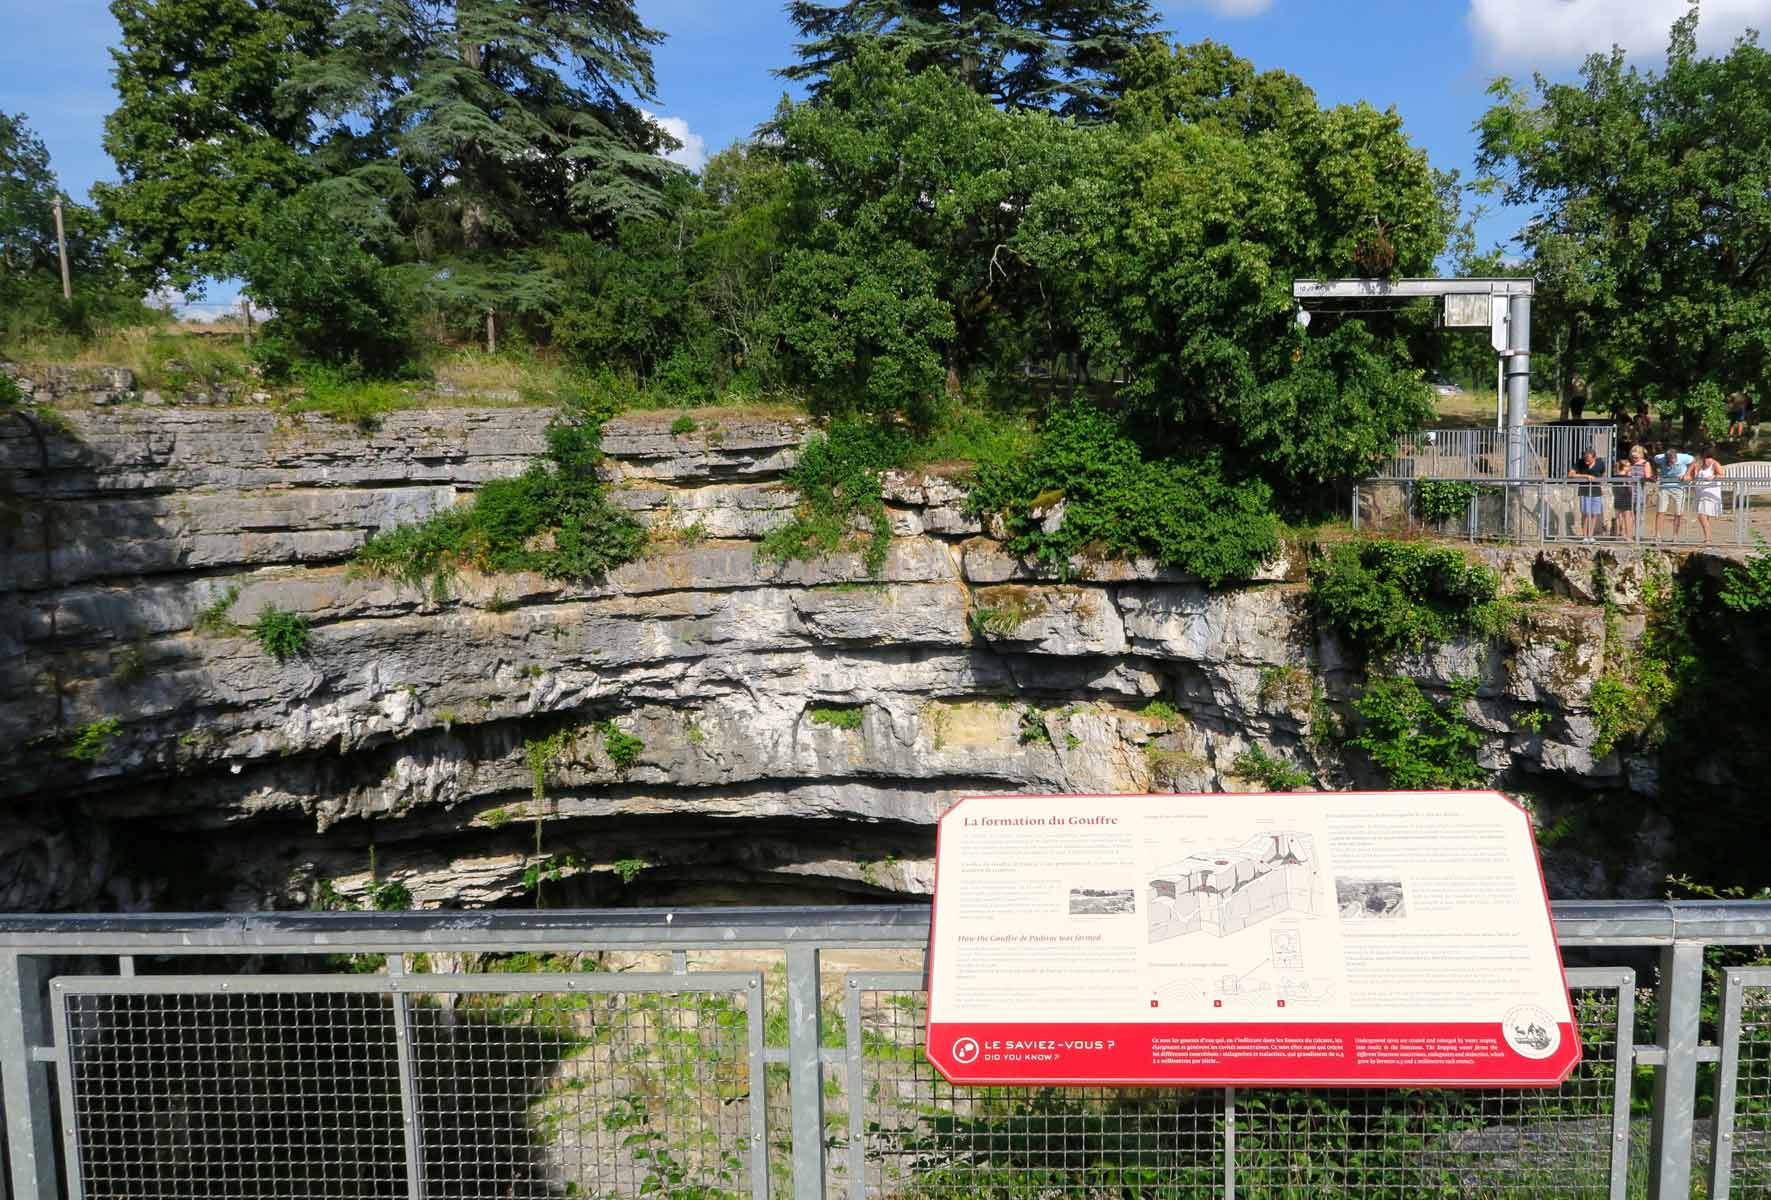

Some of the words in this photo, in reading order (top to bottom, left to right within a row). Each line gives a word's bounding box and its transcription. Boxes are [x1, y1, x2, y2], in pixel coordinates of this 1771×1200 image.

[964, 816, 978, 827] La
[981, 816, 1045, 827] formation
[1048, 815, 1066, 826] du
[1068, 815, 1119, 826] Gouffre
[958, 935, 974, 943] How
[976, 935, 988, 943] the
[1019, 935, 1027, 943] de
[985, 1040, 1001, 1050] LE
[1005, 1040, 1104, 1050] SAVIEZ-VOUS
[1107, 1040, 1115, 1050] ?
[984, 1053, 1001, 1061] DID
[1003, 1053, 1022, 1061] YOU
[1024, 1053, 1052, 1061] KNOW
